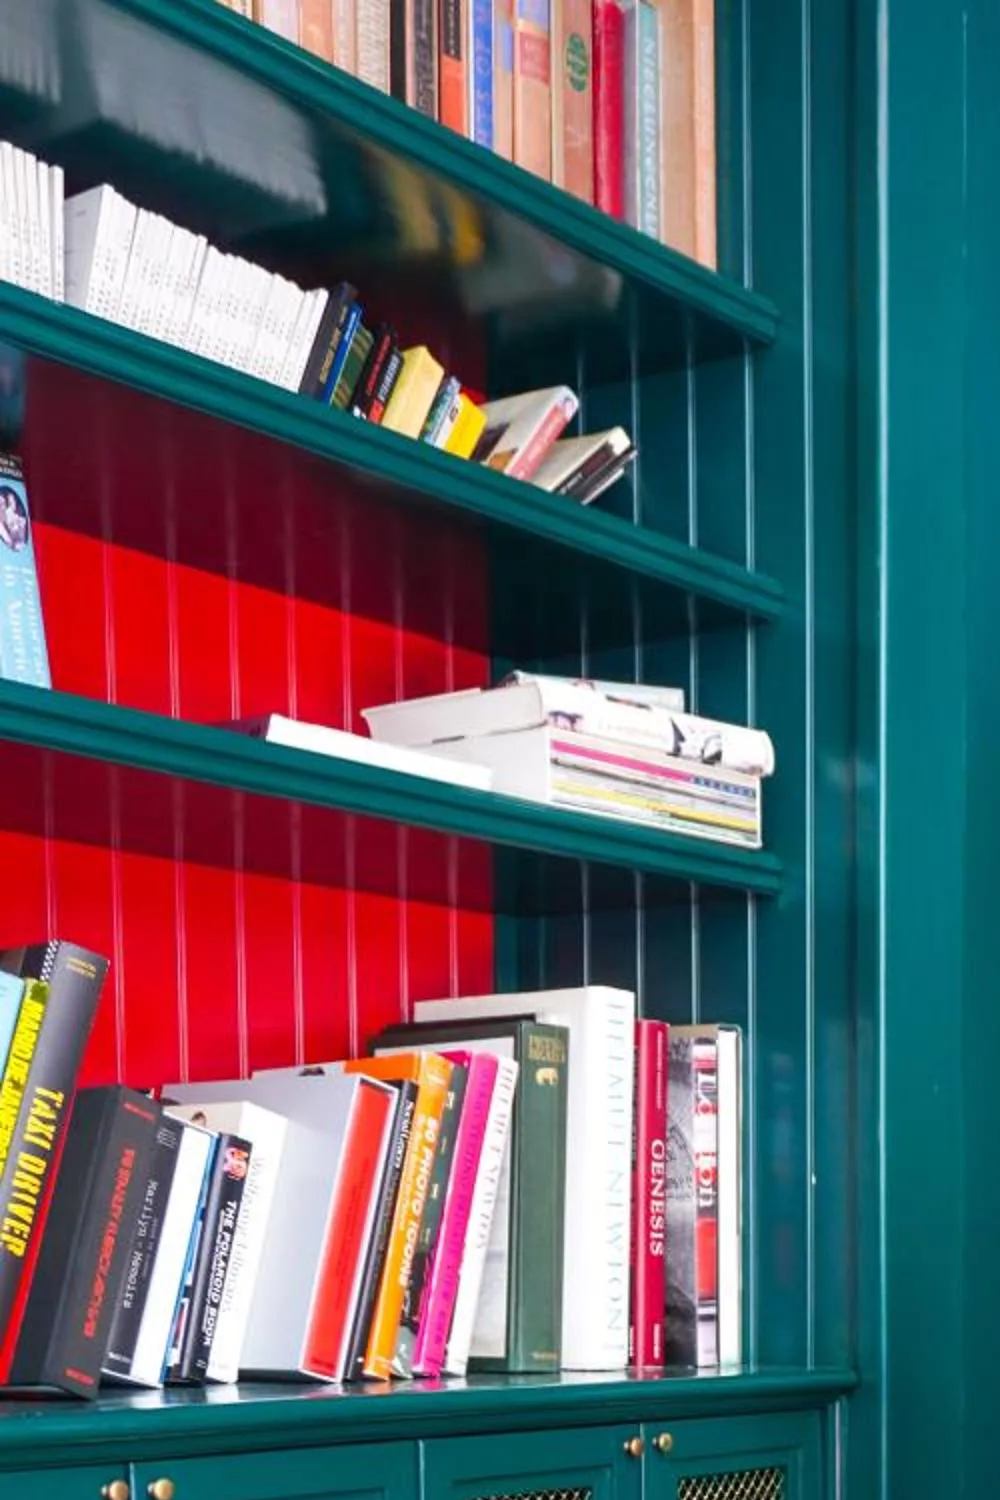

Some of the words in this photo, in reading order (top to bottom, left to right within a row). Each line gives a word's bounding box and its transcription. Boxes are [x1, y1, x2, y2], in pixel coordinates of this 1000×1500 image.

[22, 1086, 65, 1152] TAXI
[423, 1116, 439, 1142] 50
[696, 1072, 717, 1209] Loon
[0, 1151, 47, 1257] DRIVER
[134, 1178, 160, 1239] Marilyn
[410, 1146, 433, 1216] PHOTO
[648, 1139, 665, 1257] GENESIS
[222, 1200, 238, 1230] THE
[210, 1231, 232, 1303] POLAROID
[397, 1221, 420, 1287] ICONS
[202, 1306, 218, 1347] BOOK
